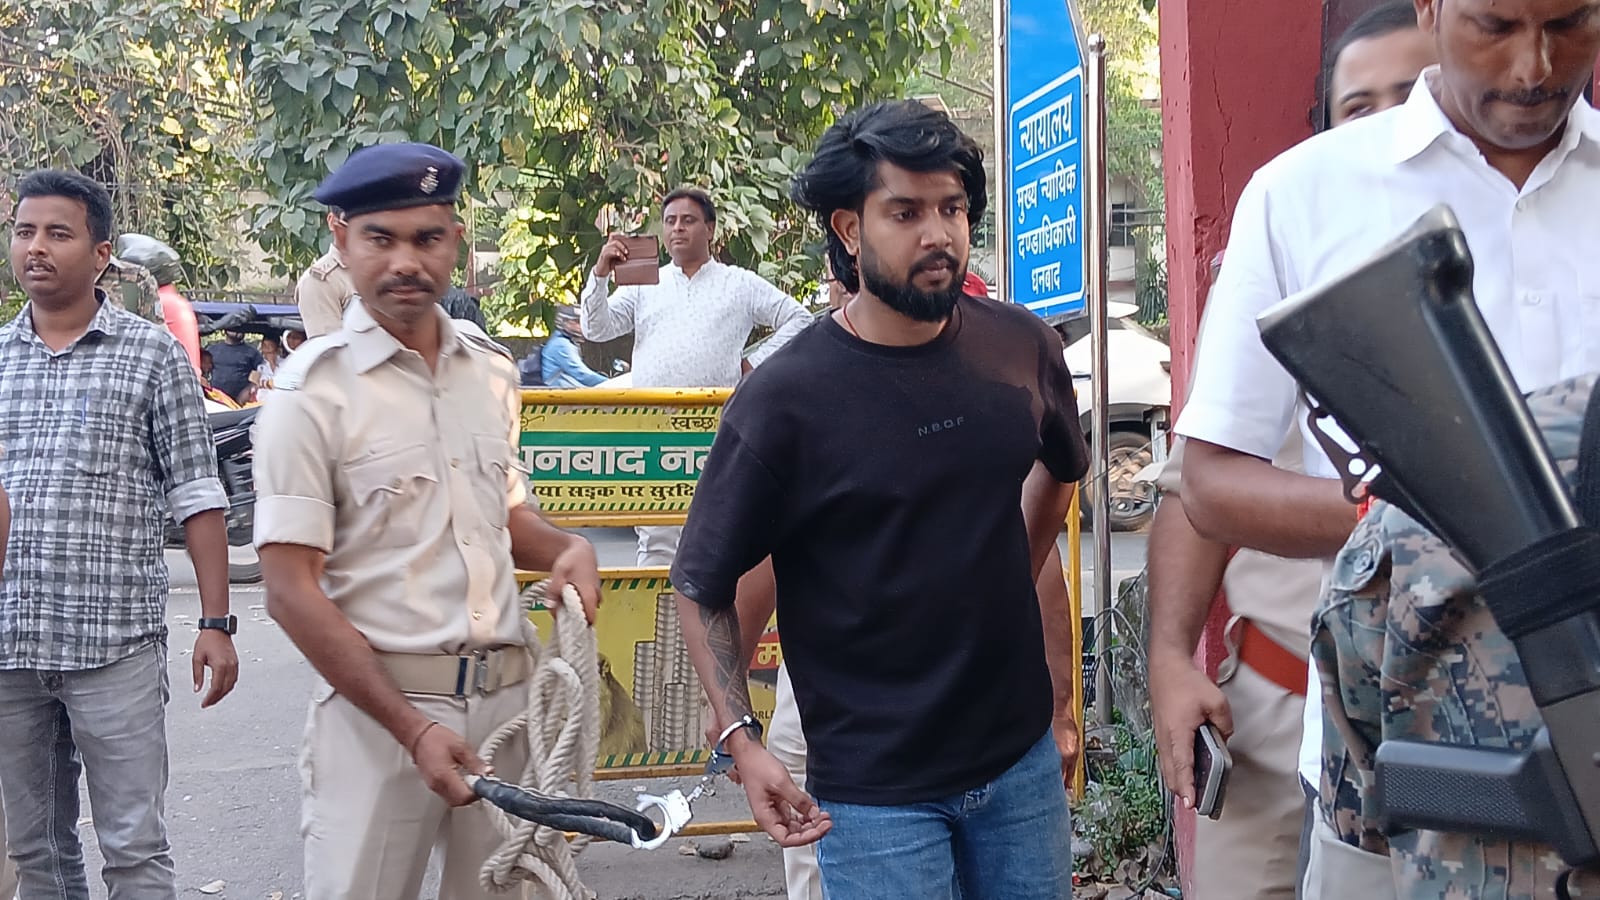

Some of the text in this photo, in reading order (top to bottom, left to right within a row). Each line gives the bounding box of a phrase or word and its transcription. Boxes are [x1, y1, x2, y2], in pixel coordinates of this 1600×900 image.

[1018, 93, 1073, 156] न्यायालय
[1016, 160, 1076, 223] मुख्य न्यायिक
[1017, 205, 1076, 259] दण्डाधिकारी
[1031, 262, 1061, 294] धनबाद
[620, 485, 645, 497] पर
